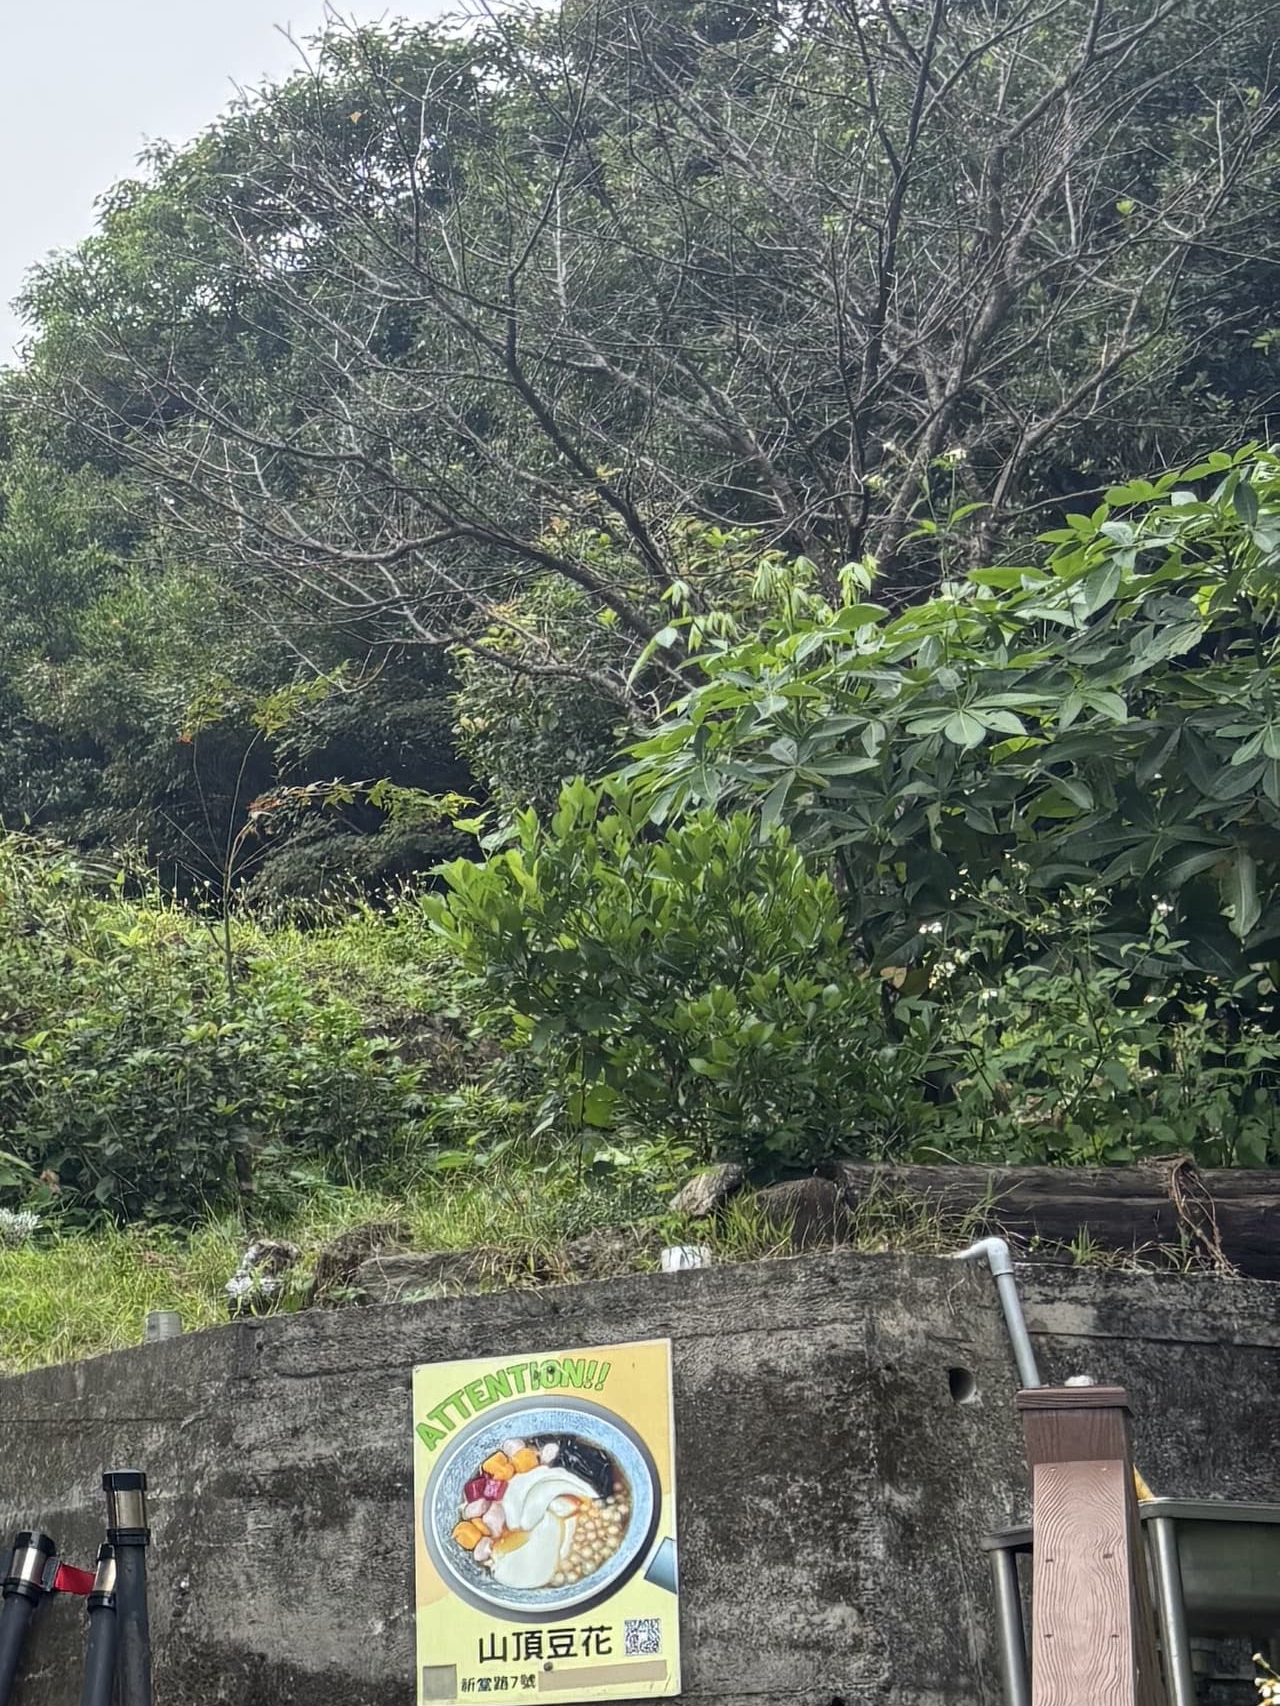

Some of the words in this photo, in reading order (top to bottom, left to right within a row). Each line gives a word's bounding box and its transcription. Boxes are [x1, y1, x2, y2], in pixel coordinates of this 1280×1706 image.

[416, 1358, 611, 1451] ATTENTION!!
[479, 1625, 613, 1663] 山頂豆花
